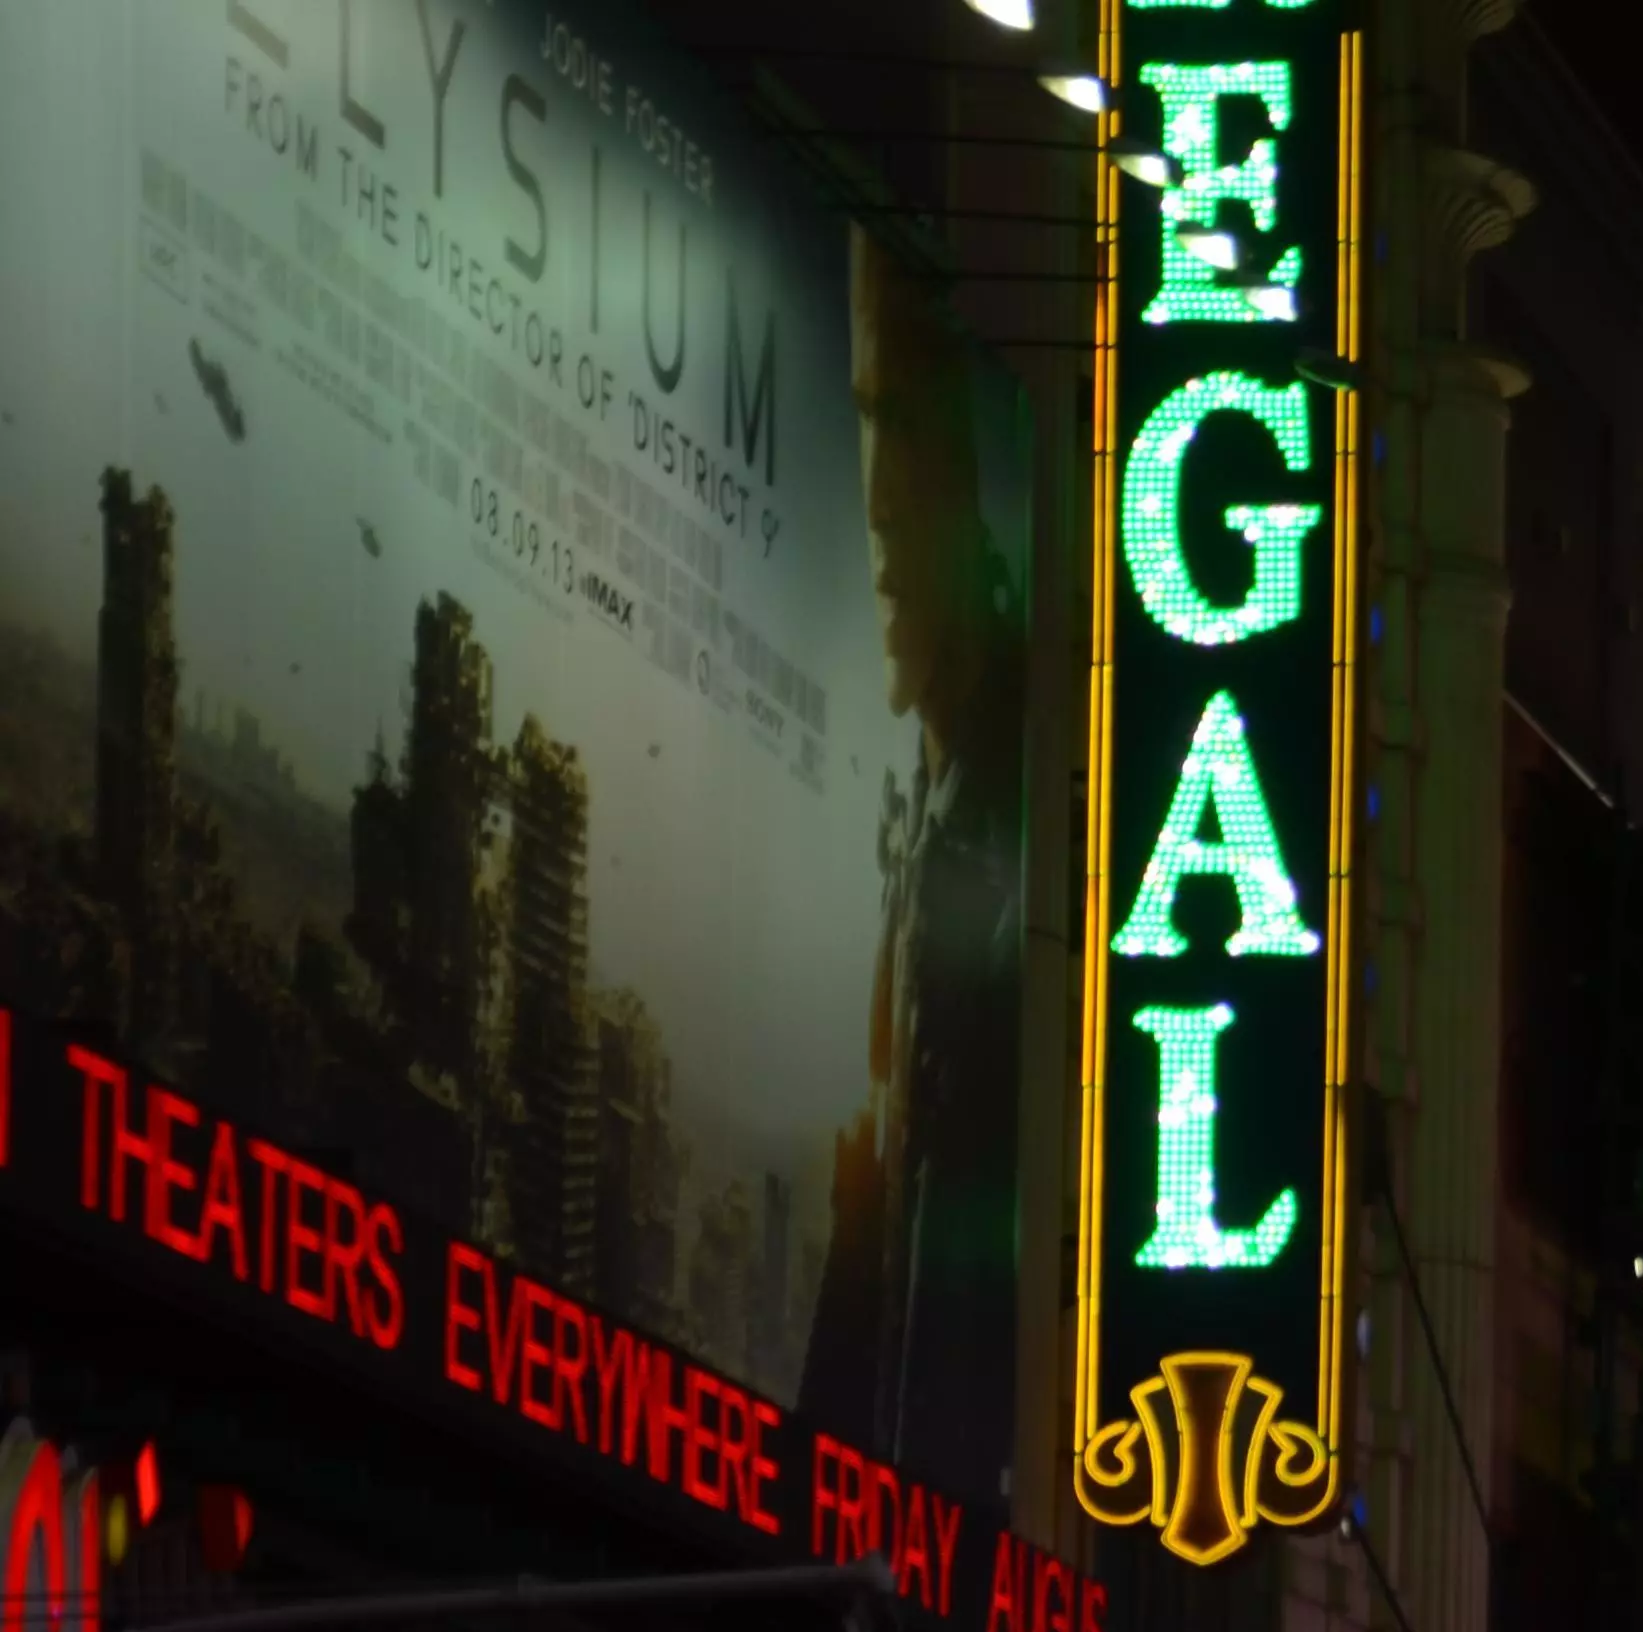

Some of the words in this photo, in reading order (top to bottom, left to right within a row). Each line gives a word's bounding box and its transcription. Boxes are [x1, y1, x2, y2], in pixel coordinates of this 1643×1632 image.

[223, 57, 319, 180] FROM
[337, 146, 399, 248] THE
[413, 211, 564, 391] DIRECTOR
[576, 351, 614, 424] OF
[540, 12, 614, 117] JODIE
[624, 94, 716, 204] FOSTER
[471, 477, 576, 596] 08.09.13
[586, 571, 635, 631] IMAX
[1110, 0, 1325, 1270] EGAL
[65, 1040, 405, 1350] THEATERS
[444, 1239, 782, 1536] EVERYWHERE
[812, 1430, 963, 1618] FRIDAY
